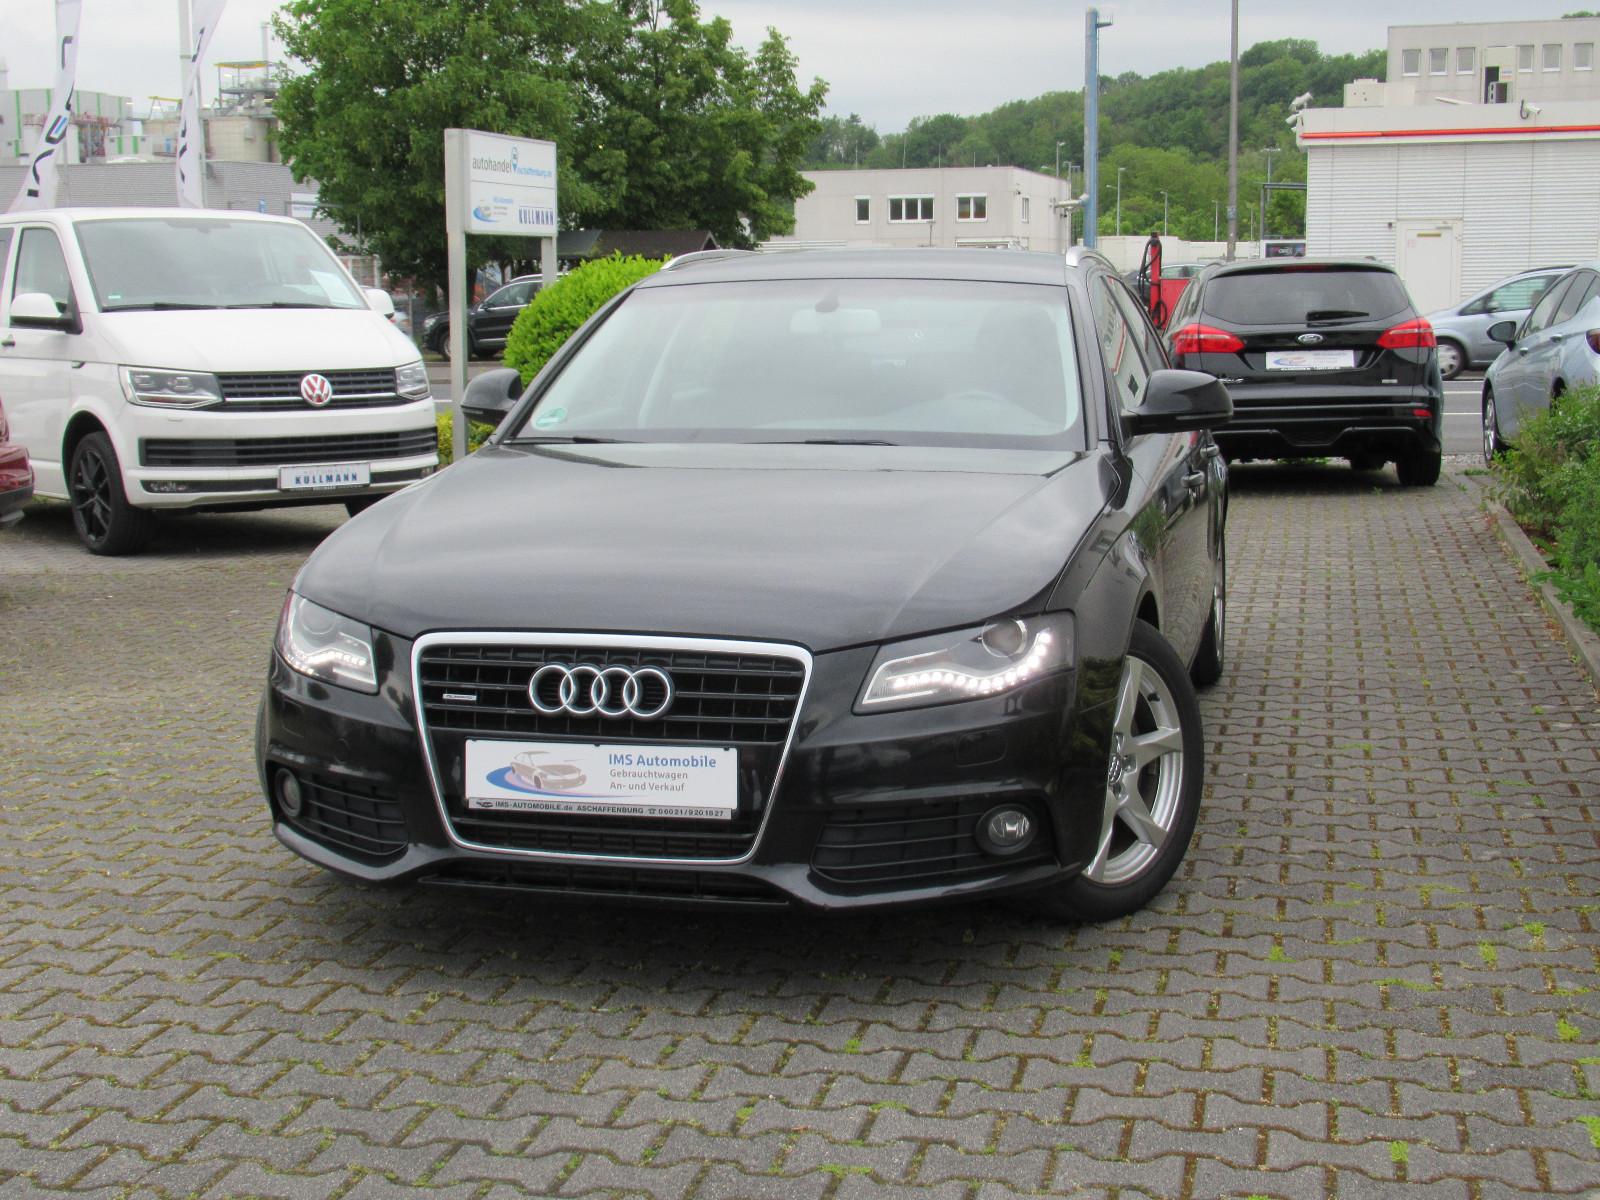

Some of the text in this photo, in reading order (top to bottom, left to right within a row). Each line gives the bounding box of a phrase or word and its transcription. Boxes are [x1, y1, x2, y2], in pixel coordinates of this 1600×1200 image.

[472, 156, 512, 173] autohandel
[518, 208, 554, 225] KULLMANN
[608, 753, 717, 768] IMS Automobile
[609, 768, 688, 781] Gebrauchtwagen
[609, 781, 685, 792] An- und Verkauf
[576, 805, 644, 815] ASCHAFFENBURG
